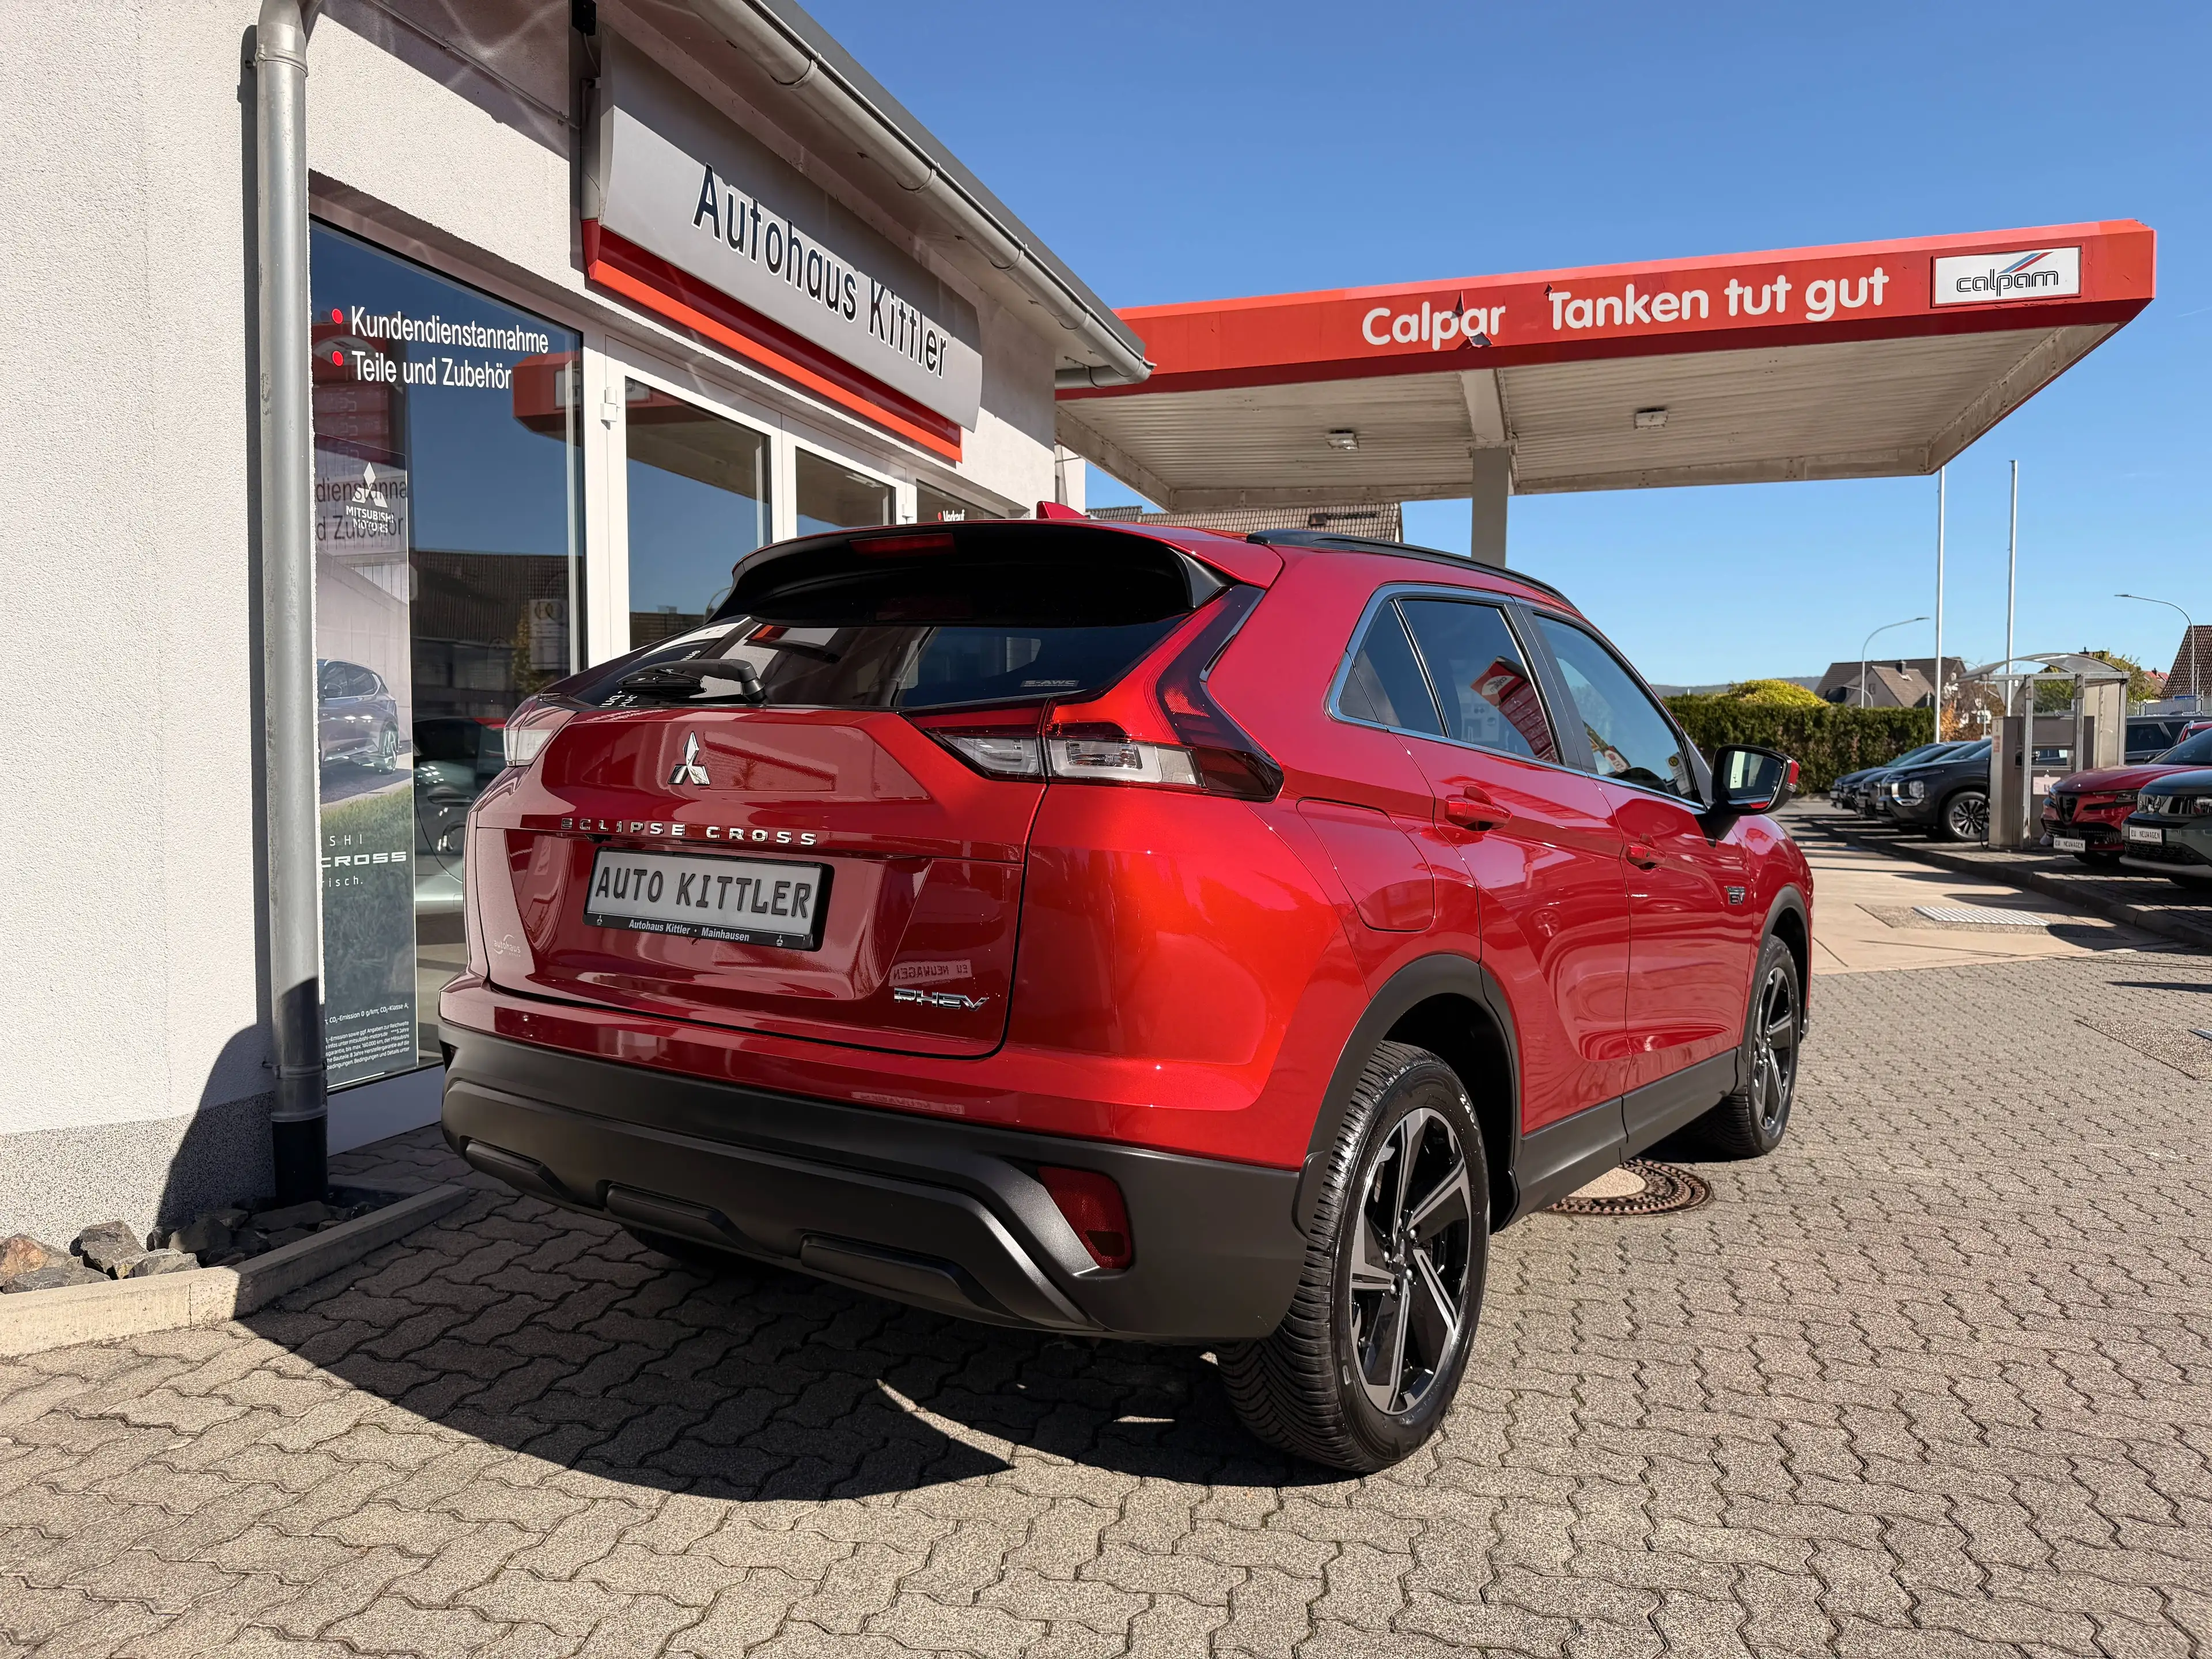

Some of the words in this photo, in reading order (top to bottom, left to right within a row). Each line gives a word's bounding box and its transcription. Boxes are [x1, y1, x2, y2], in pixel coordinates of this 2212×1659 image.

[691, 162, 858, 323] Autohaus
[868, 275, 948, 379] Kittler
[1956, 267, 2059, 297] calpam
[1362, 301, 1506, 351] Calpar
[1548, 283, 1709, 331] Tanken
[1724, 274, 1792, 317] tut
[1805, 266, 1889, 322] gut
[351, 305, 549, 354] Kundendienstannahme
[351, 350, 397, 382] Teile
[403, 357, 437, 385] und
[441, 358, 512, 389] Zubehör
[346, 505, 394, 524] MITSUBISHI
[353, 518, 388, 533] MOTORS
[560, 817, 686, 836] ECLIPSE
[706, 826, 817, 846] CROSS
[2139, 831, 2160, 839] NEUWAGEN
[595, 866, 664, 903] AUTO
[676, 872, 812, 919] KITTLER
[628, 919, 664, 932] Autohaus
[665, 922, 691, 935] Kittler
[701, 927, 750, 942] Mainhausen
[494, 940, 521, 953] autohaus
[894, 987, 990, 1012] PHEV
